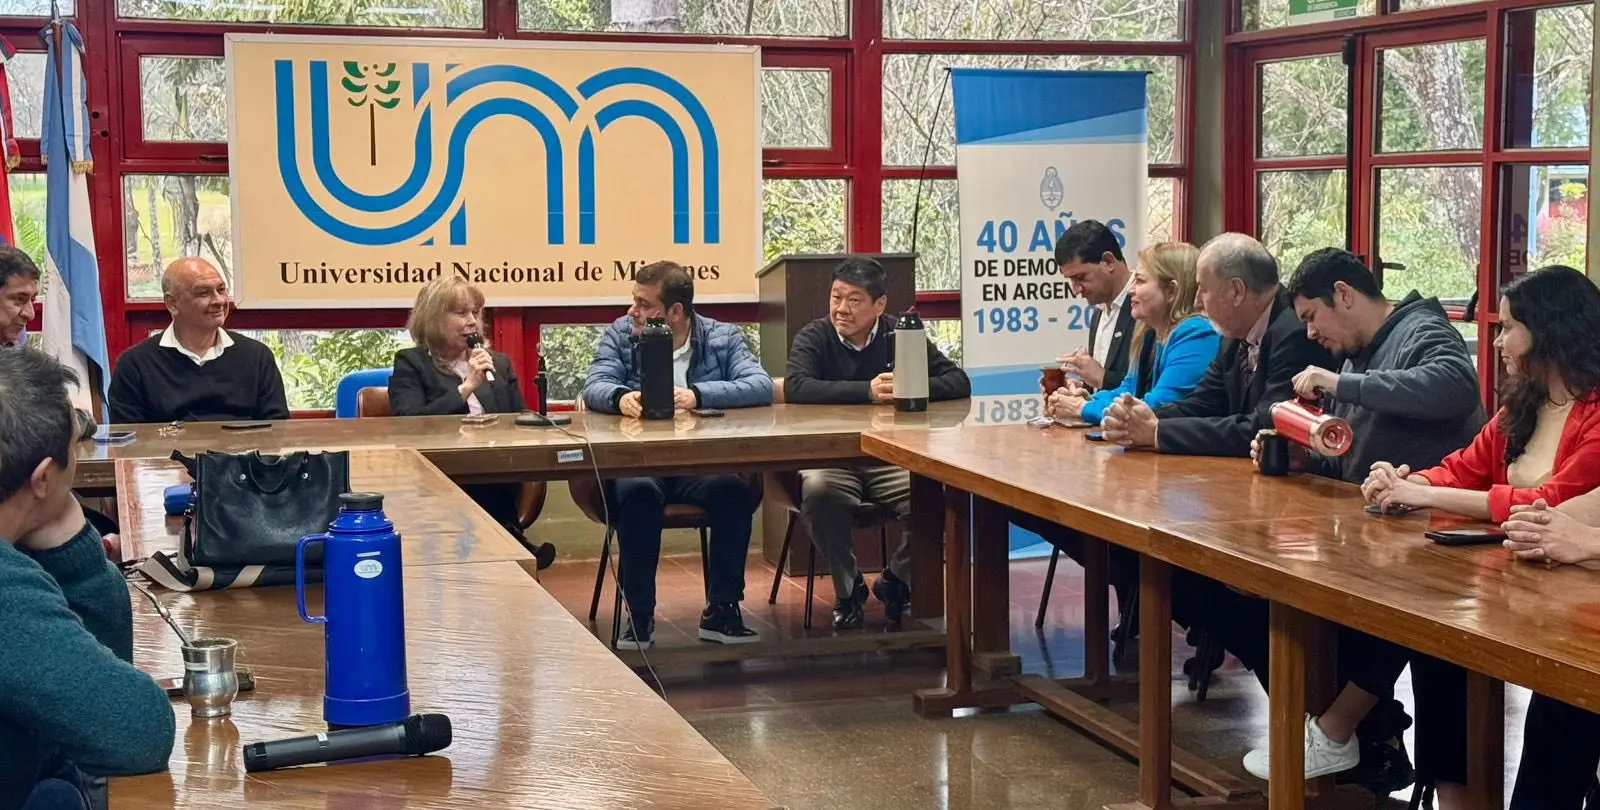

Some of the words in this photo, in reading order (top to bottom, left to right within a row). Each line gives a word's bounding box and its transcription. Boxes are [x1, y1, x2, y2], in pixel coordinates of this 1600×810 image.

[977, 220, 1018, 253] 40
[1029, 211, 1126, 253] AÑS
[279, 262, 441, 284] Universidad
[451, 261, 564, 283] Nacional
[575, 260, 603, 281] de
[974, 259, 998, 277] DE
[1004, 258, 1064, 277] DEMO
[983, 283, 1007, 301] EN
[1013, 282, 1077, 300] ARGEN
[973, 306, 1039, 333] 1983
